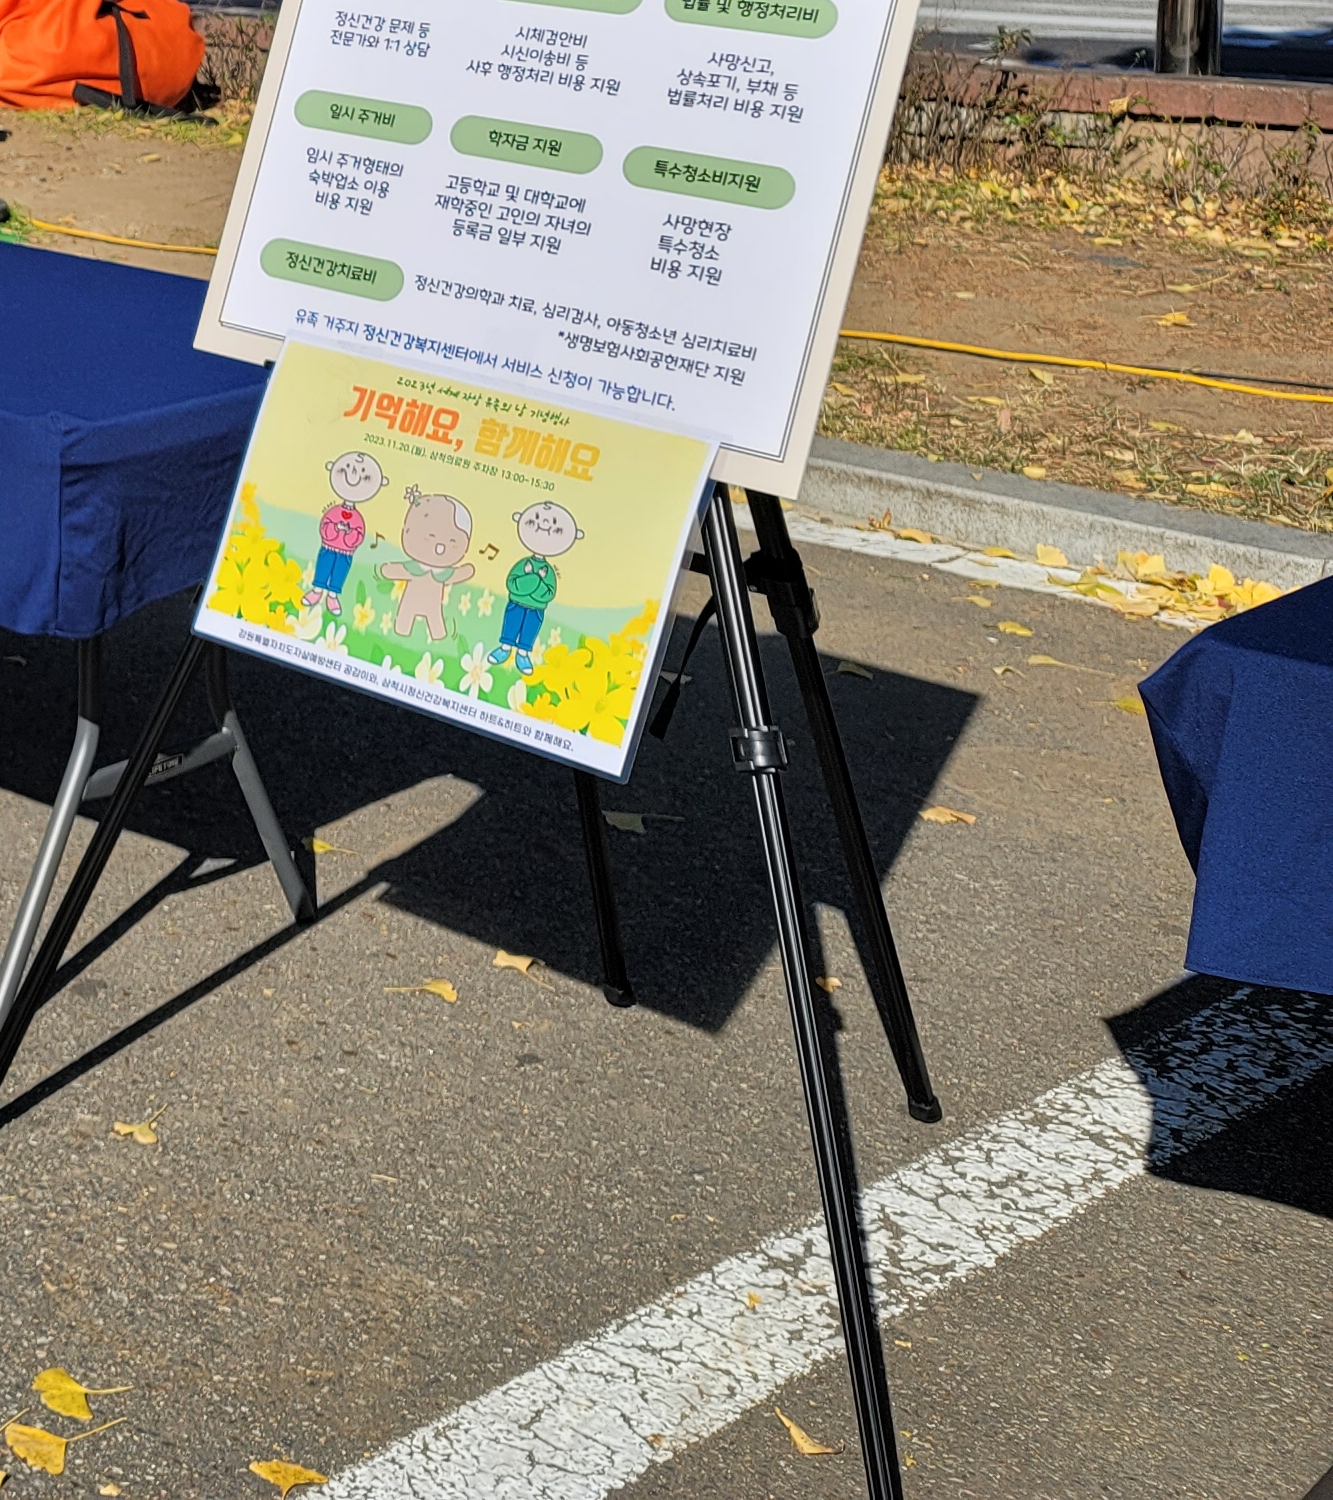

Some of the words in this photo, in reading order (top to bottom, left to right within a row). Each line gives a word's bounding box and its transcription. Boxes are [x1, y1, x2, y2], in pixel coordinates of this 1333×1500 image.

[335, 10, 385, 32] 정신건강
[388, 18, 414, 34] 문제
[418, 22, 430, 38] 등
[737, 0, 819, 22] 행정처리비
[330, 29, 379, 47] 전문가와
[384, 37, 400, 51] 1:1
[403, 40, 430, 57] 상담
[515, 26, 587, 48] 시체검안비
[500, 44, 571, 66] 시신이송비
[574, 53, 588, 71] 등
[707, 52, 774, 76] 사망신고,
[465, 59, 493, 76] 사후
[497, 63, 554, 84] 행정처리
[557, 72, 585, 91] 비용
[589, 77, 620, 96] 지원
[676, 68, 739, 92] 상속포기,
[746, 78, 778, 96] 부채
[782, 83, 798, 101] 등
[329, 103, 355, 120] 일시
[357, 108, 395, 127] 주거비
[667, 88, 729, 110] 법률처리
[733, 98, 764, 118] 비용
[769, 103, 803, 123] 지원
[489, 129, 529, 151] 학자금
[532, 137, 562, 156] 지원
[306, 147, 333, 164] 임시
[336, 152, 403, 176] 주거형태의
[654, 160, 760, 192] 특수청소비지원
[308, 169, 358, 190] 숙박업소
[363, 179, 389, 198] 이용
[445, 174, 500, 196] 고등학교
[505, 184, 519, 202] 및
[523, 188, 586, 212] 대학교에
[315, 190, 340, 210] 비용
[344, 196, 373, 215] 지원
[434, 194, 492, 219] 재학중인
[495, 205, 540, 225] 고인의
[544, 214, 591, 235] 자녀의
[452, 218, 492, 241] 등록금
[497, 227, 526, 246] 일부
[529, 234, 561, 254] 지원
[662, 214, 731, 241] 사망현장
[658, 234, 719, 260] 특수청소
[286, 251, 376, 283] 정신건강치료비
[650, 257, 681, 278] 비용
[686, 264, 722, 286] 지원
[415, 274, 504, 305] 정신건강의학과
[507, 294, 536, 315] 치료,
[542, 302, 600, 329] 심리검사,
[606, 317, 676, 344] 아동청소년
[681, 332, 757, 360] 심리치료비
[295, 308, 318, 327] 유족
[323, 315, 359, 335] 거주지
[363, 324, 497, 367] 정신건강복지센터에서
[501, 357, 542, 378] 서비스
[547, 367, 592, 390] 신청이
[598, 379, 674, 410] 가능합니다.
[713, 365, 745, 386] 지원
[343, 384, 464, 452] 기억해요,
[473, 416, 601, 482] 함께해요
